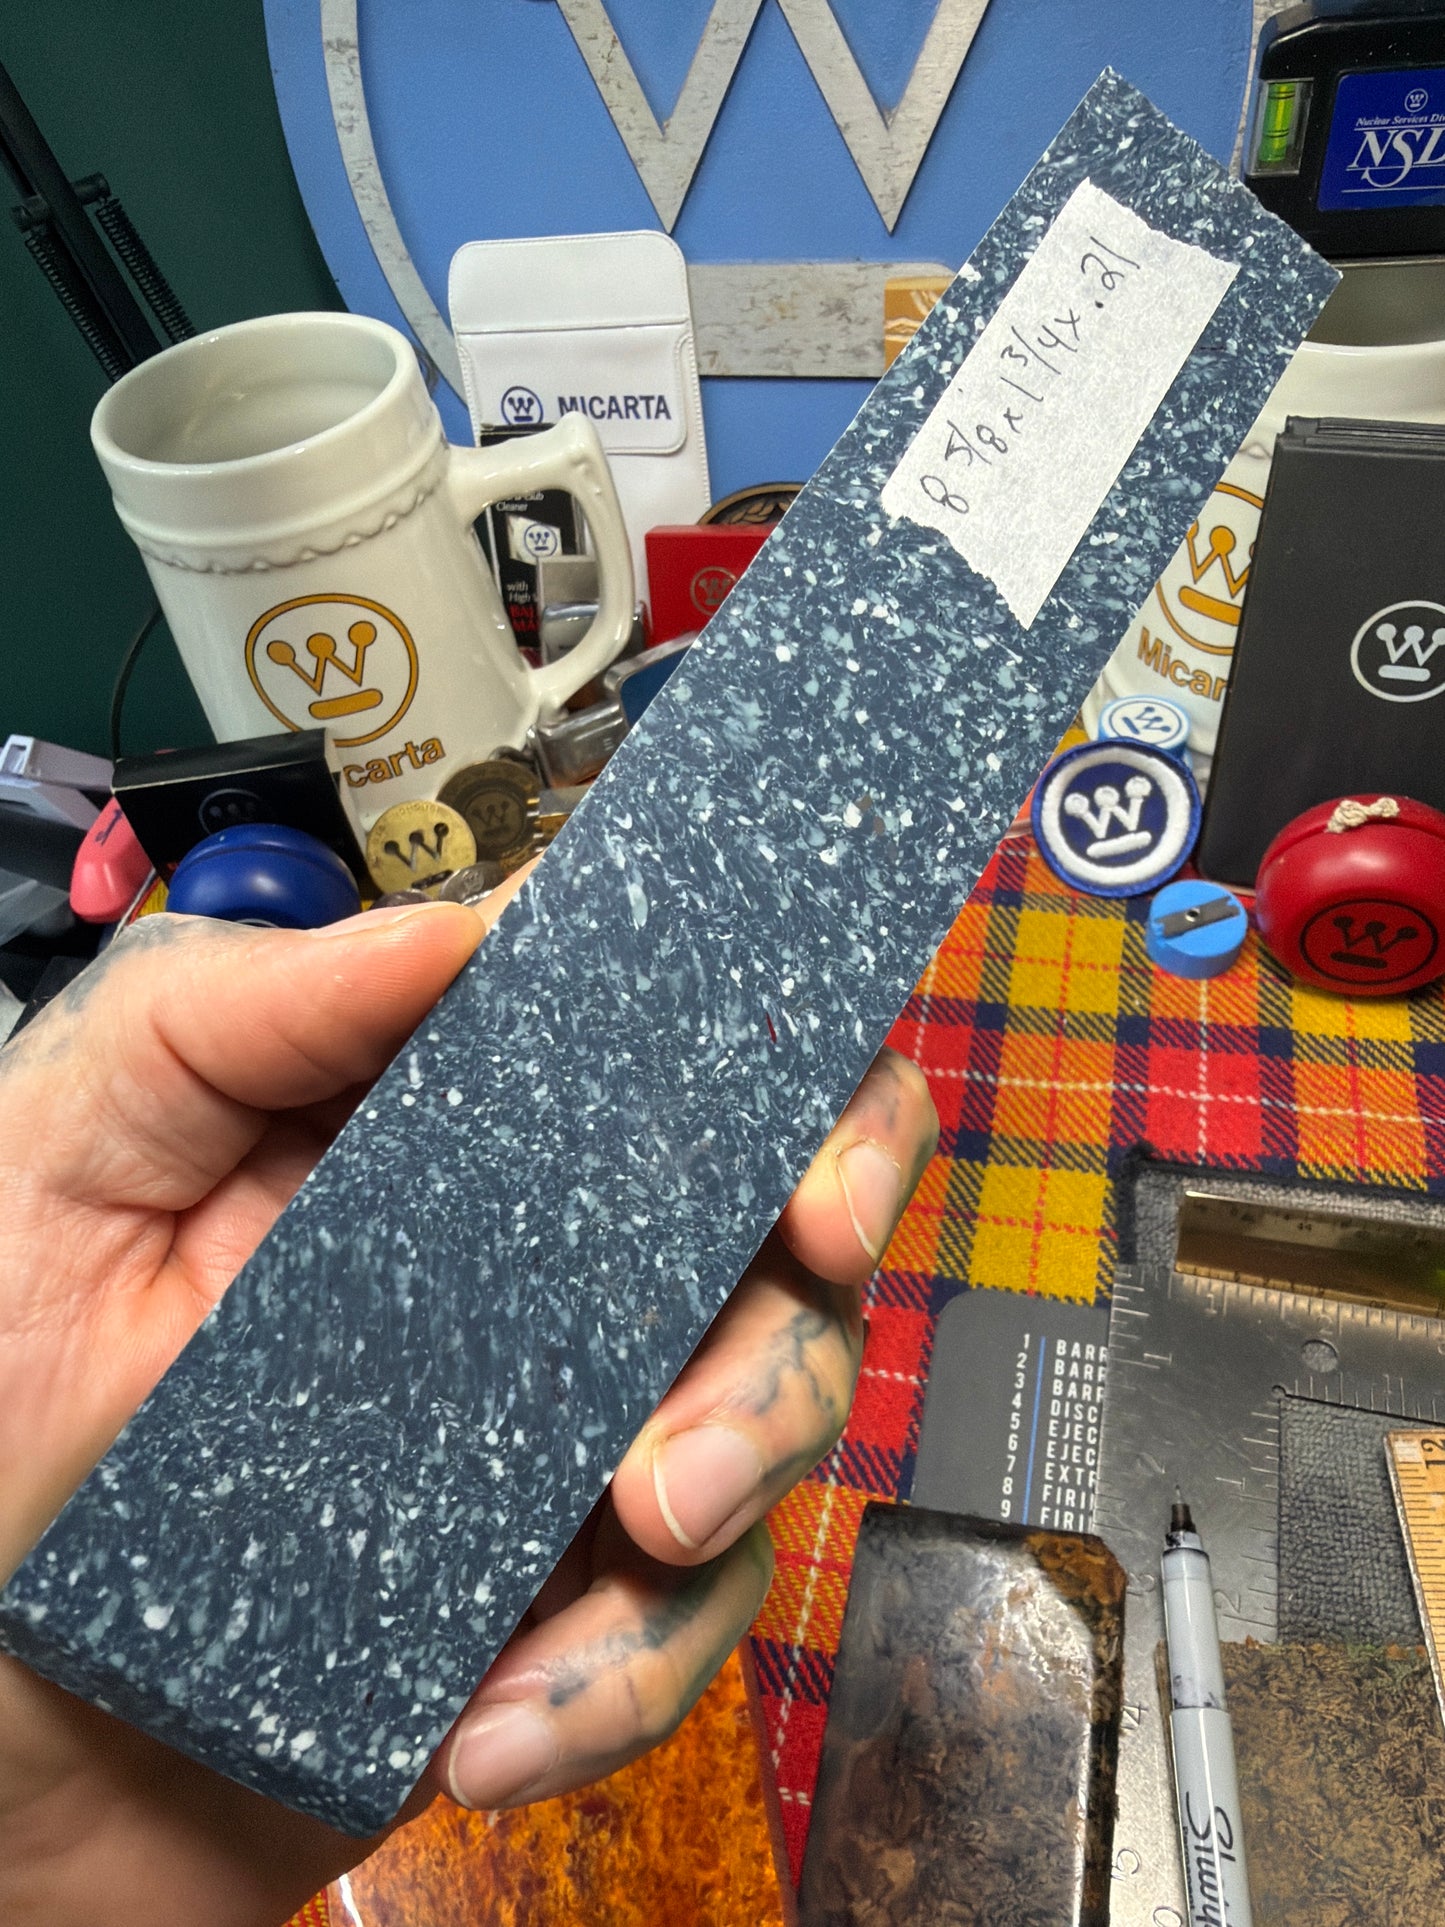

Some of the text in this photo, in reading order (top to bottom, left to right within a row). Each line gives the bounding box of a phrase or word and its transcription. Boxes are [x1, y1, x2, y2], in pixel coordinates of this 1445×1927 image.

[1355, 117, 1391, 127] Nuclear
[1392, 115, 1428, 125] Services
[557, 395, 672, 420] MICARTA
[496, 501, 528, 512] Cleaner
[1137, 626, 1228, 702] Micar
[343, 737, 446, 788] carta
[1024, 1333, 1030, 1349] 1
[1016, 1352, 1027, 1369] 2
[1014, 1372, 1025, 1389] 3
[1011, 1392, 1098, 1423] 4 DISC
[1010, 1412, 1098, 1445] 5 EJEC
[1008, 1433, 1096, 1466] 6 EJEC
[1007, 1454, 1016, 1472] 7
[1002, 1477, 1013, 1495] 8
[1001, 1499, 1011, 1517] 9
